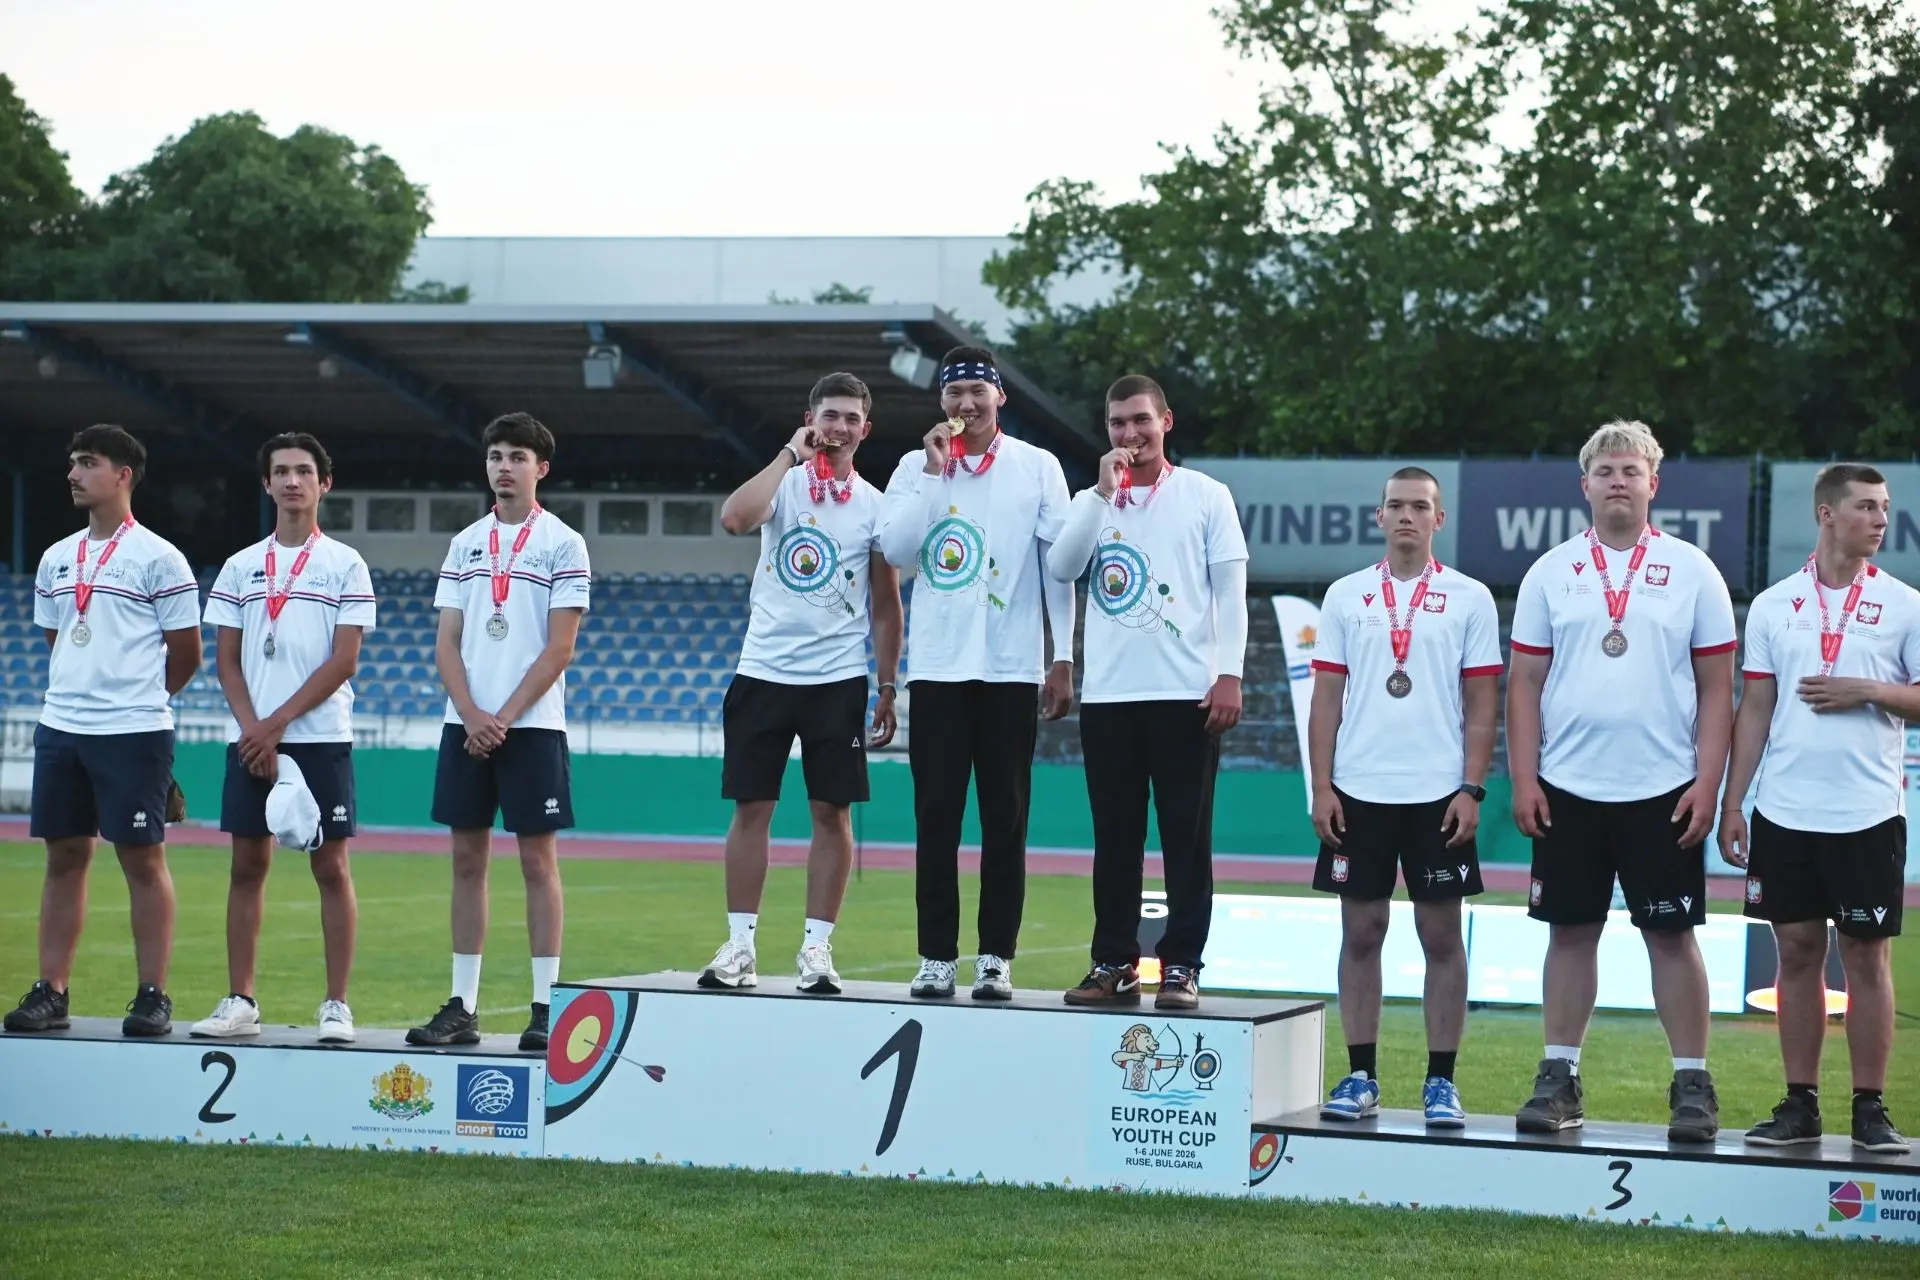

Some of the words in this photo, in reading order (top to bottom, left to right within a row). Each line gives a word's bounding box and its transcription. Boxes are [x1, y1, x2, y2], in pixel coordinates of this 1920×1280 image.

[1234, 504, 1386, 545] INBE
[1496, 507, 1722, 551] WINET
[198, 1051, 236, 1123] 2
[861, 1019, 922, 1156] 1
[1111, 1106, 1217, 1126] EUROPEAN
[456, 1124, 494, 1135] СПОРТ
[497, 1125, 527, 1137] ТОТО
[1112, 1127, 1173, 1145] YOUTH
[1179, 1131, 1216, 1147] CUP
[1134, 1147, 1147, 1156] 1-6
[1149, 1148, 1173, 1157] JUNE
[1175, 1150, 1196, 1158] 2026
[1125, 1157, 1153, 1167] RUSE,
[1155, 1159, 1203, 1169] BULGARIA
[1605, 1161, 1633, 1210] 3
[1881, 1188, 1920, 1202] worl
